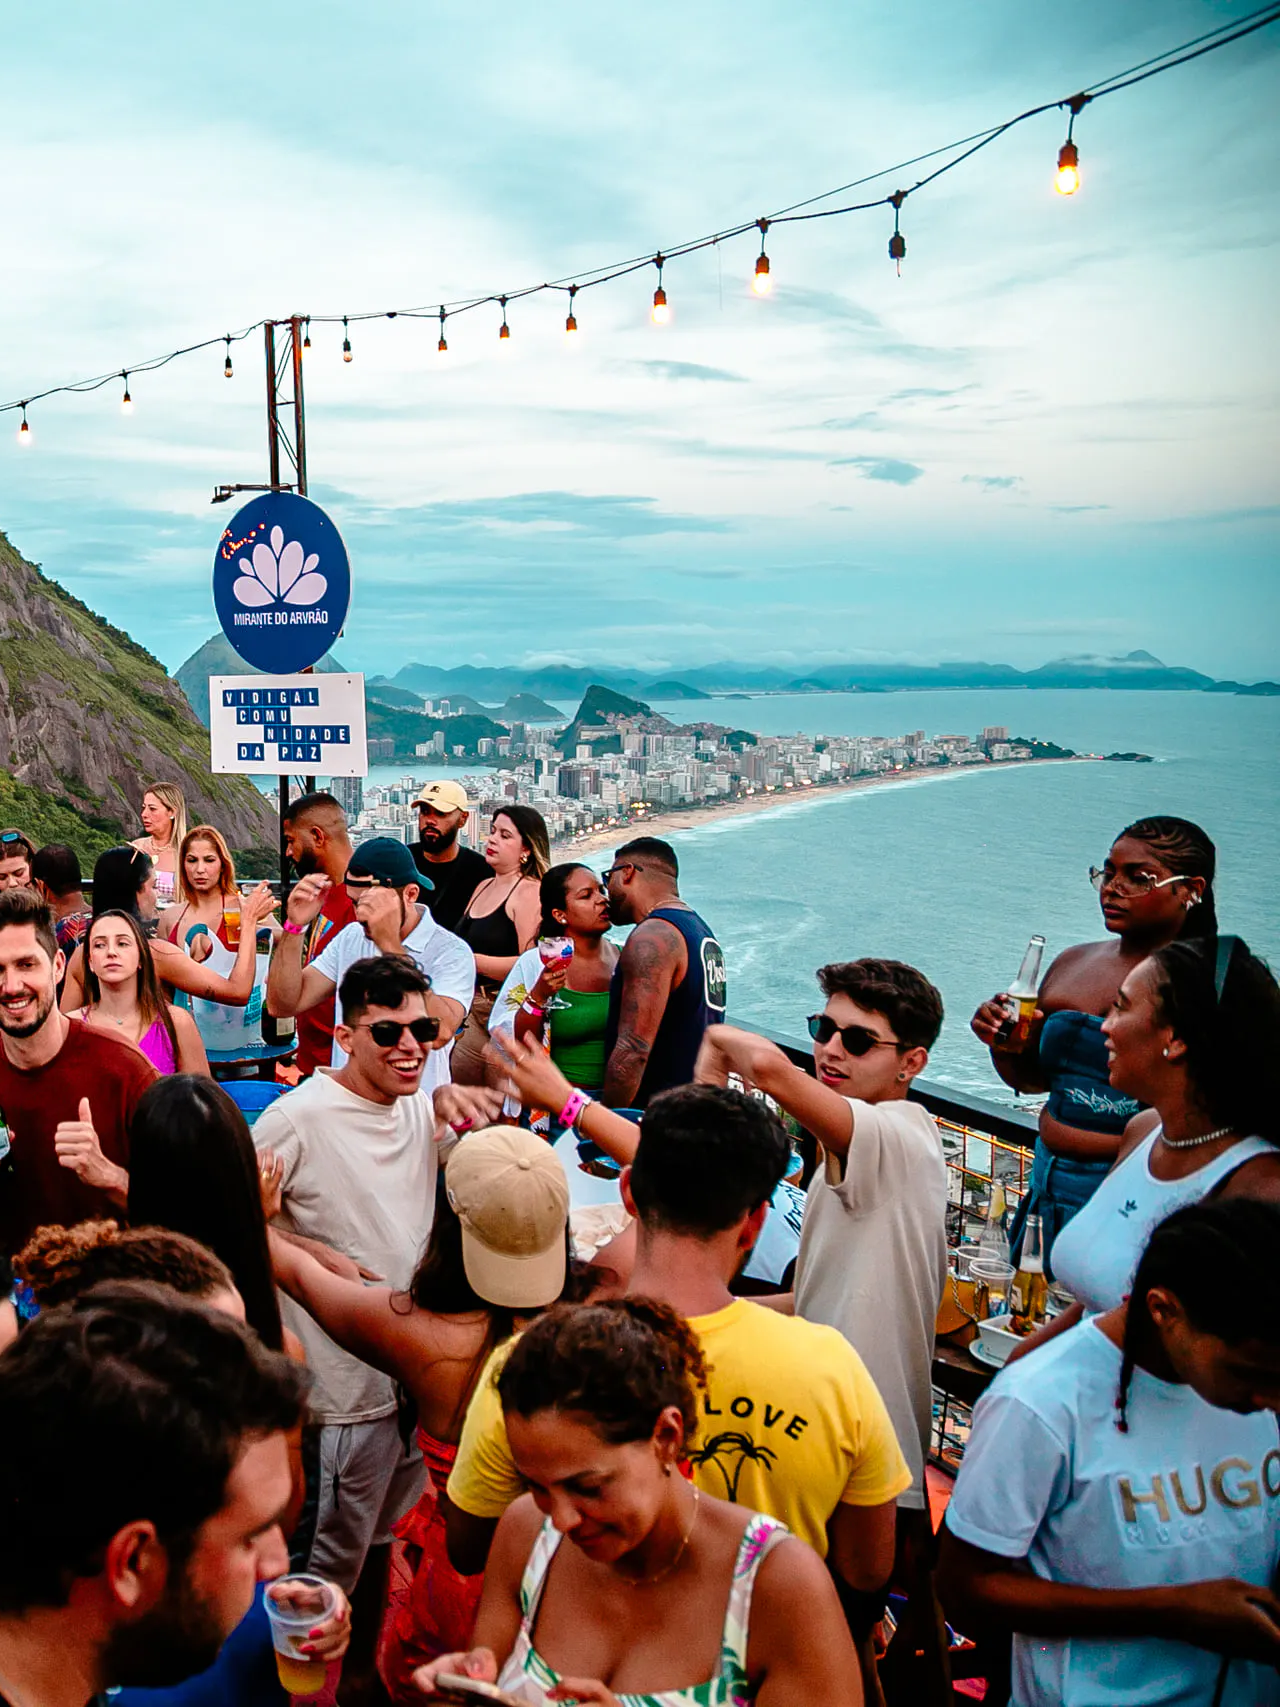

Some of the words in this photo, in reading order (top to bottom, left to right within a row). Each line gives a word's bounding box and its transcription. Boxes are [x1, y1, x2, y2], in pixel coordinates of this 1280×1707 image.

[233, 612, 273, 626] MIRANTE
[274, 611, 288, 625] DO
[289, 607, 328, 625] ARVRÃO
[225, 691, 315, 705] VIDIGAL
[240, 710, 287, 722] COMU
[267, 728, 346, 741] NIDADE
[241, 746, 261, 758] DA
[282, 747, 317, 759] PAZ
[704, 1394, 808, 1440] LOVE
[1118, 1450, 1280, 1523] HUGO
